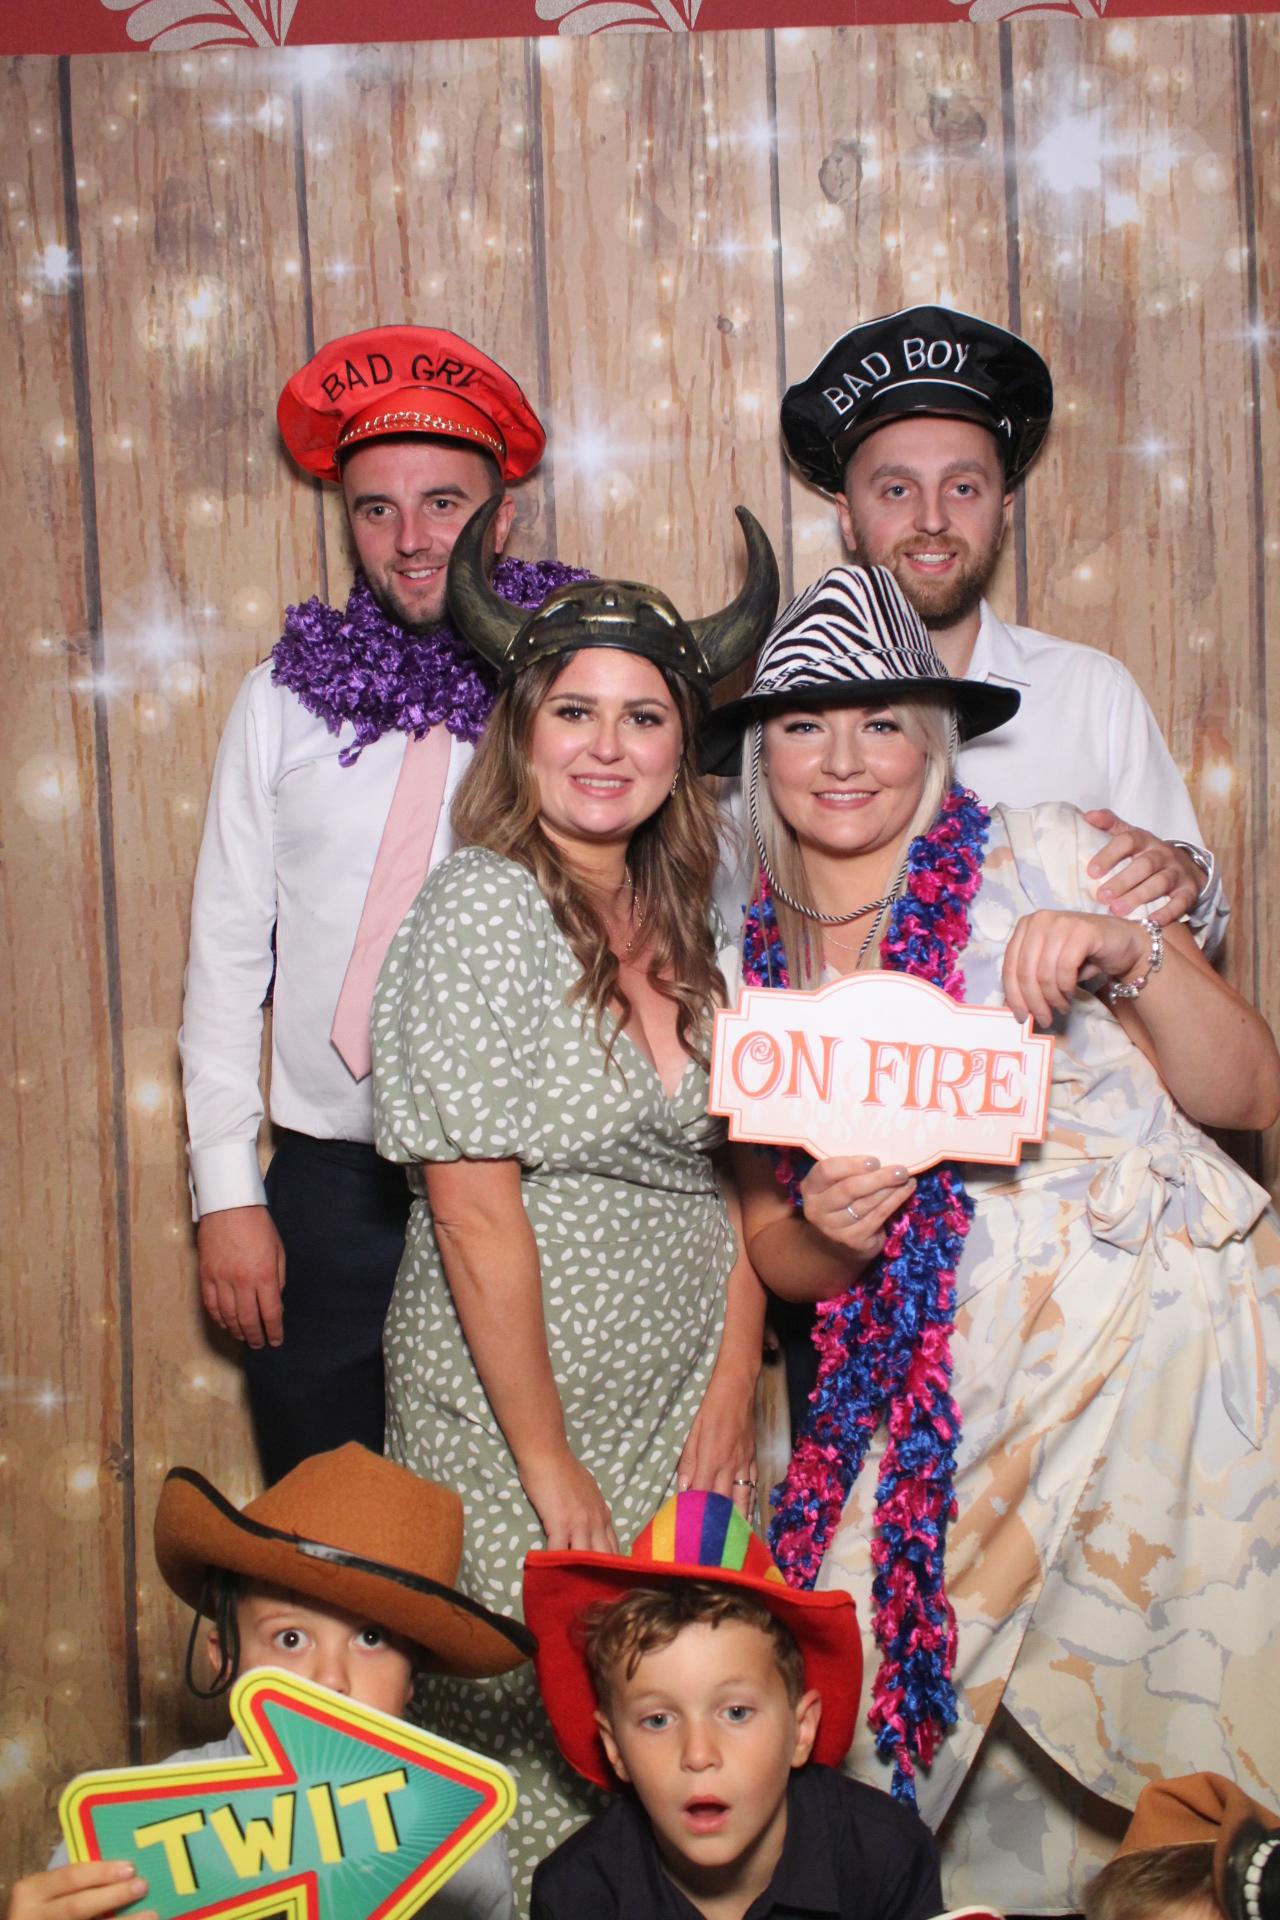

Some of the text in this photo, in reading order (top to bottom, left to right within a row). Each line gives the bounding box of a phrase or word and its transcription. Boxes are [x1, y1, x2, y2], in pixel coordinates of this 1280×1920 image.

[321, 353, 393, 403] BAD
[821, 337, 970, 416] BAD BOY
[731, 1029, 1028, 1120] ON FIRE
[133, 1768, 408, 1896] TWIT
